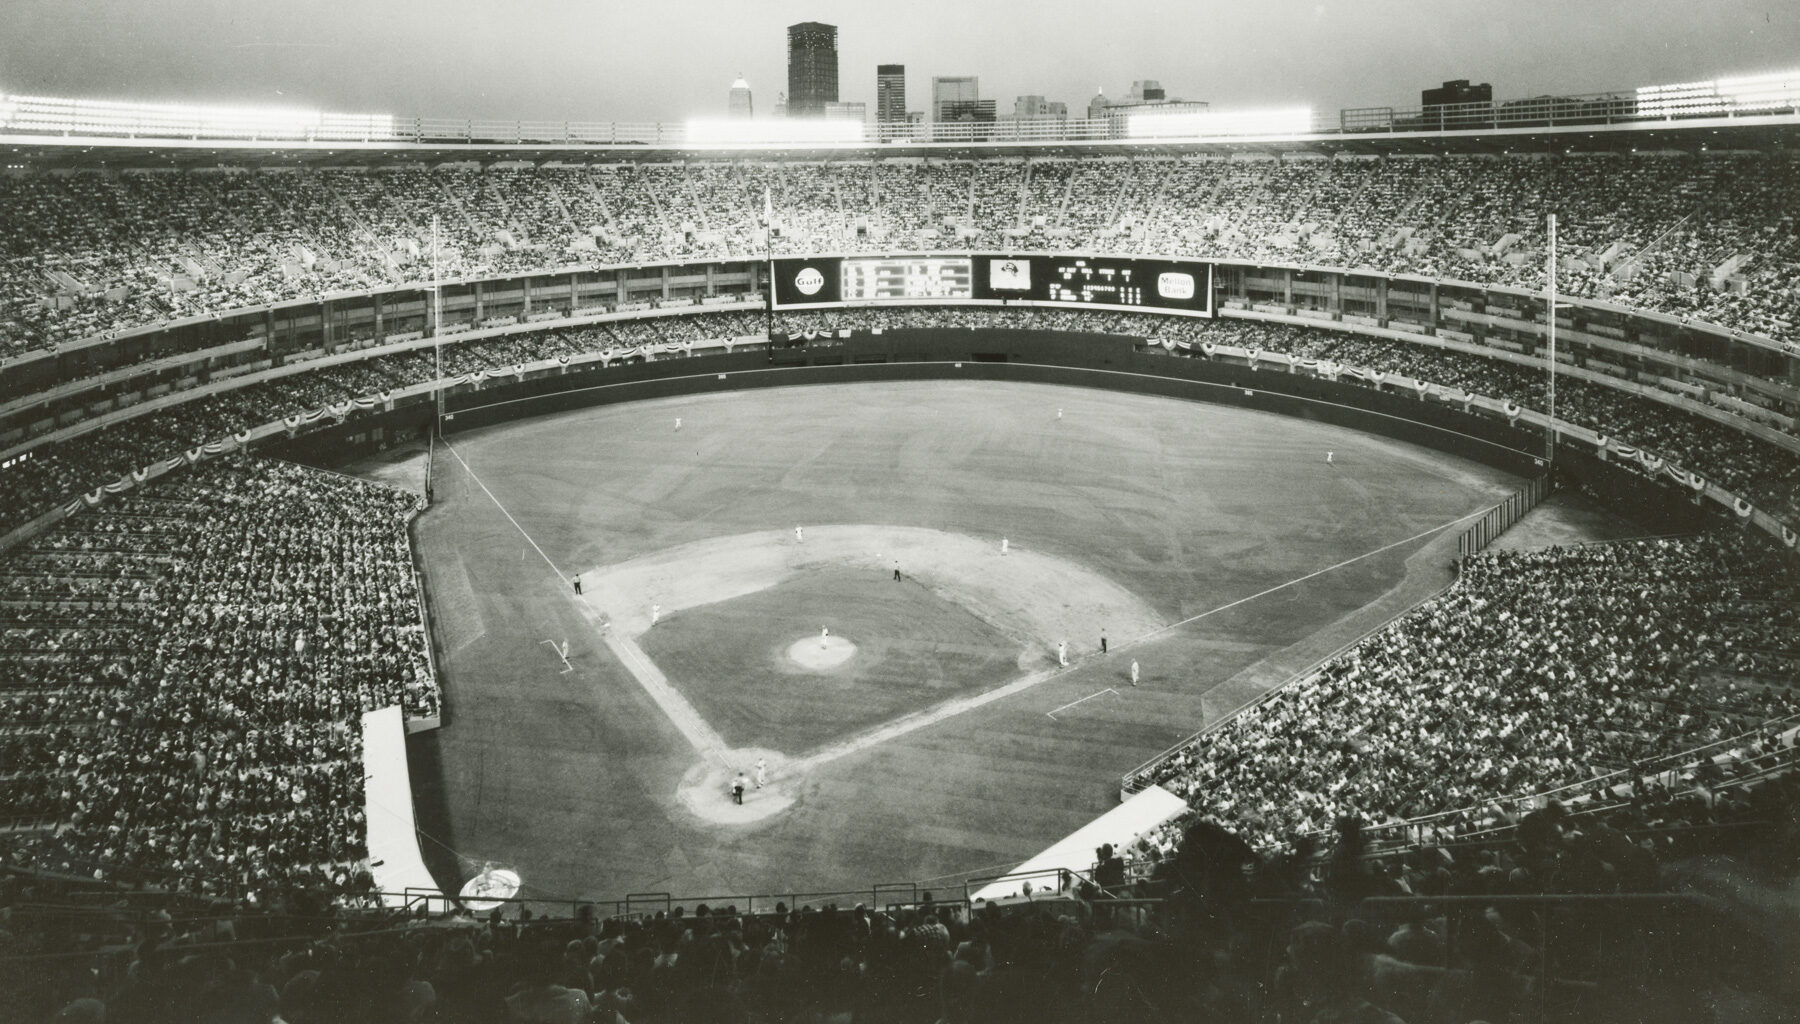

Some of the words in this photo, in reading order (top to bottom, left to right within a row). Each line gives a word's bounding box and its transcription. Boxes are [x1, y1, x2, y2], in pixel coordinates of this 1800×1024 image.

[797, 277, 822, 286] Gulf
[1161, 277, 1191, 286] Mellon
[1165, 286, 1187, 294] Bank
